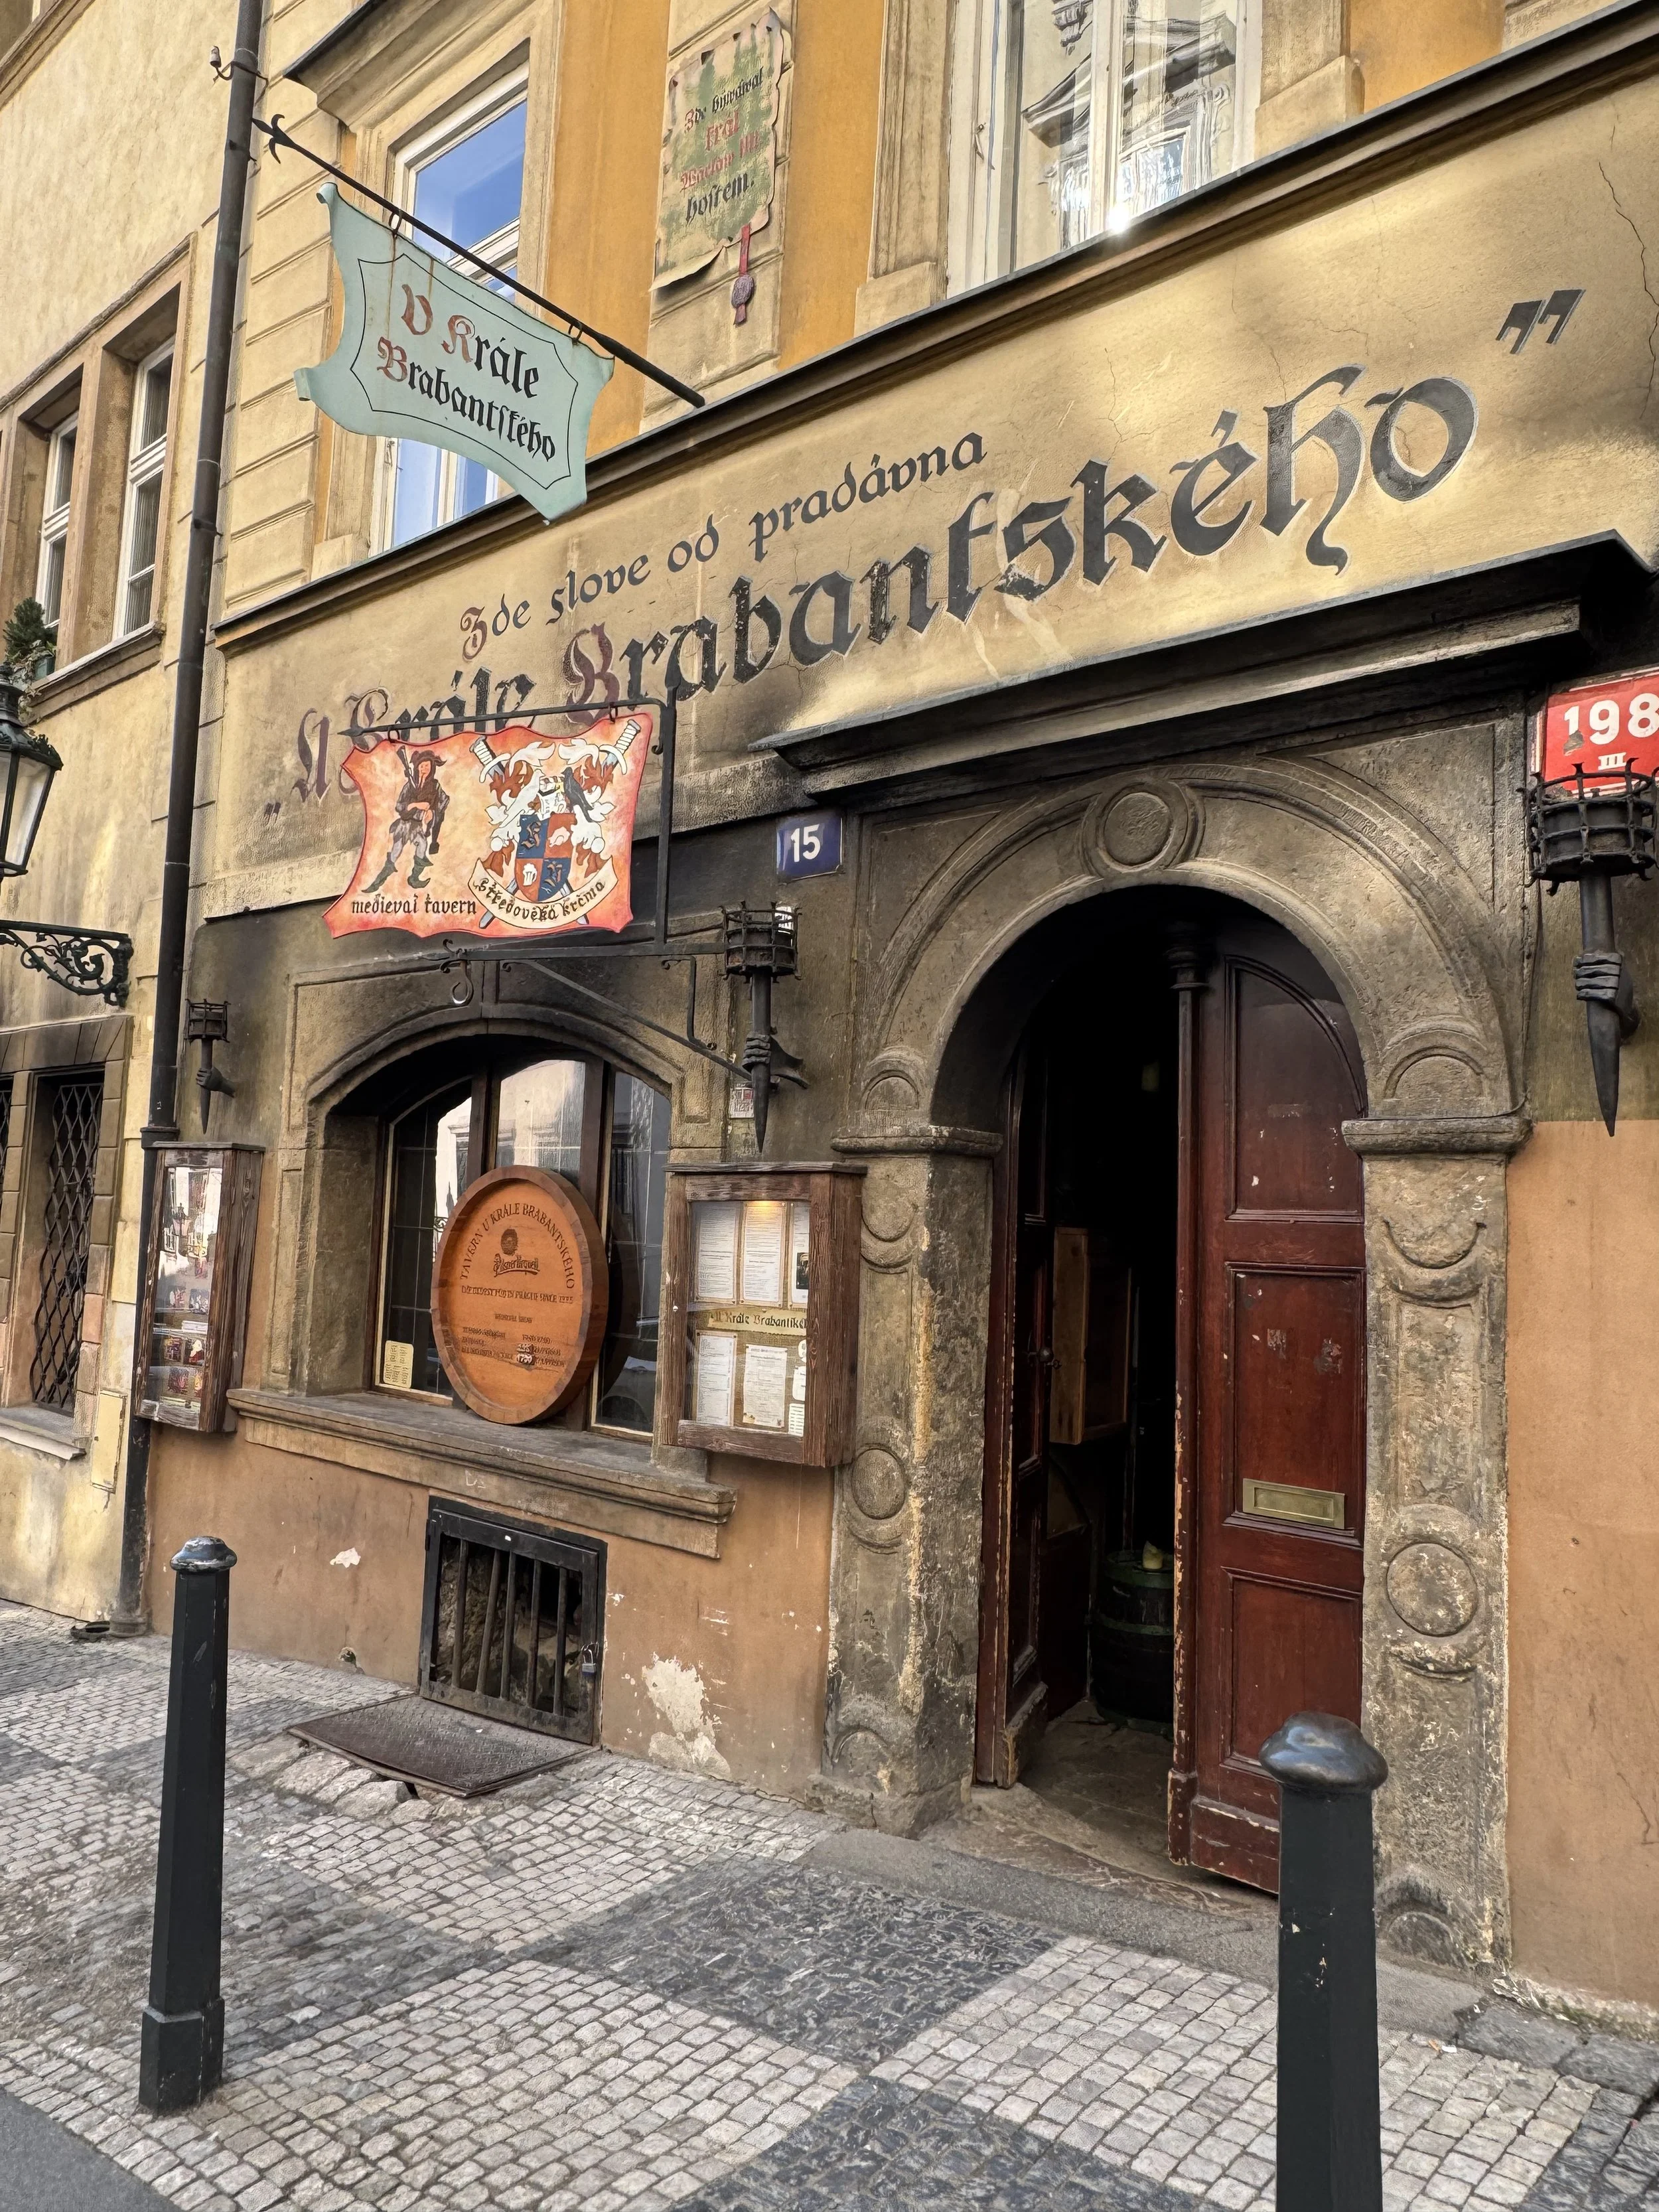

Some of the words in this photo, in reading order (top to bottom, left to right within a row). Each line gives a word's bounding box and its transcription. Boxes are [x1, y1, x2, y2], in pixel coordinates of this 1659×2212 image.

[441, 314, 540, 399] Krále
[459, 592, 532, 664] Zde
[545, 554, 652, 626] slove
[667, 514, 719, 573] od
[748, 431, 988, 563] pradávna
[1563, 692, 1659, 757] 198
[1598, 751, 1626, 771] III
[790, 823, 821, 863] 15
[352, 893, 420, 915] medieval
[424, 893, 478, 915] tavern
[460, 1228, 484, 1280] TAVERN
[482, 1218, 490, 1232] U
